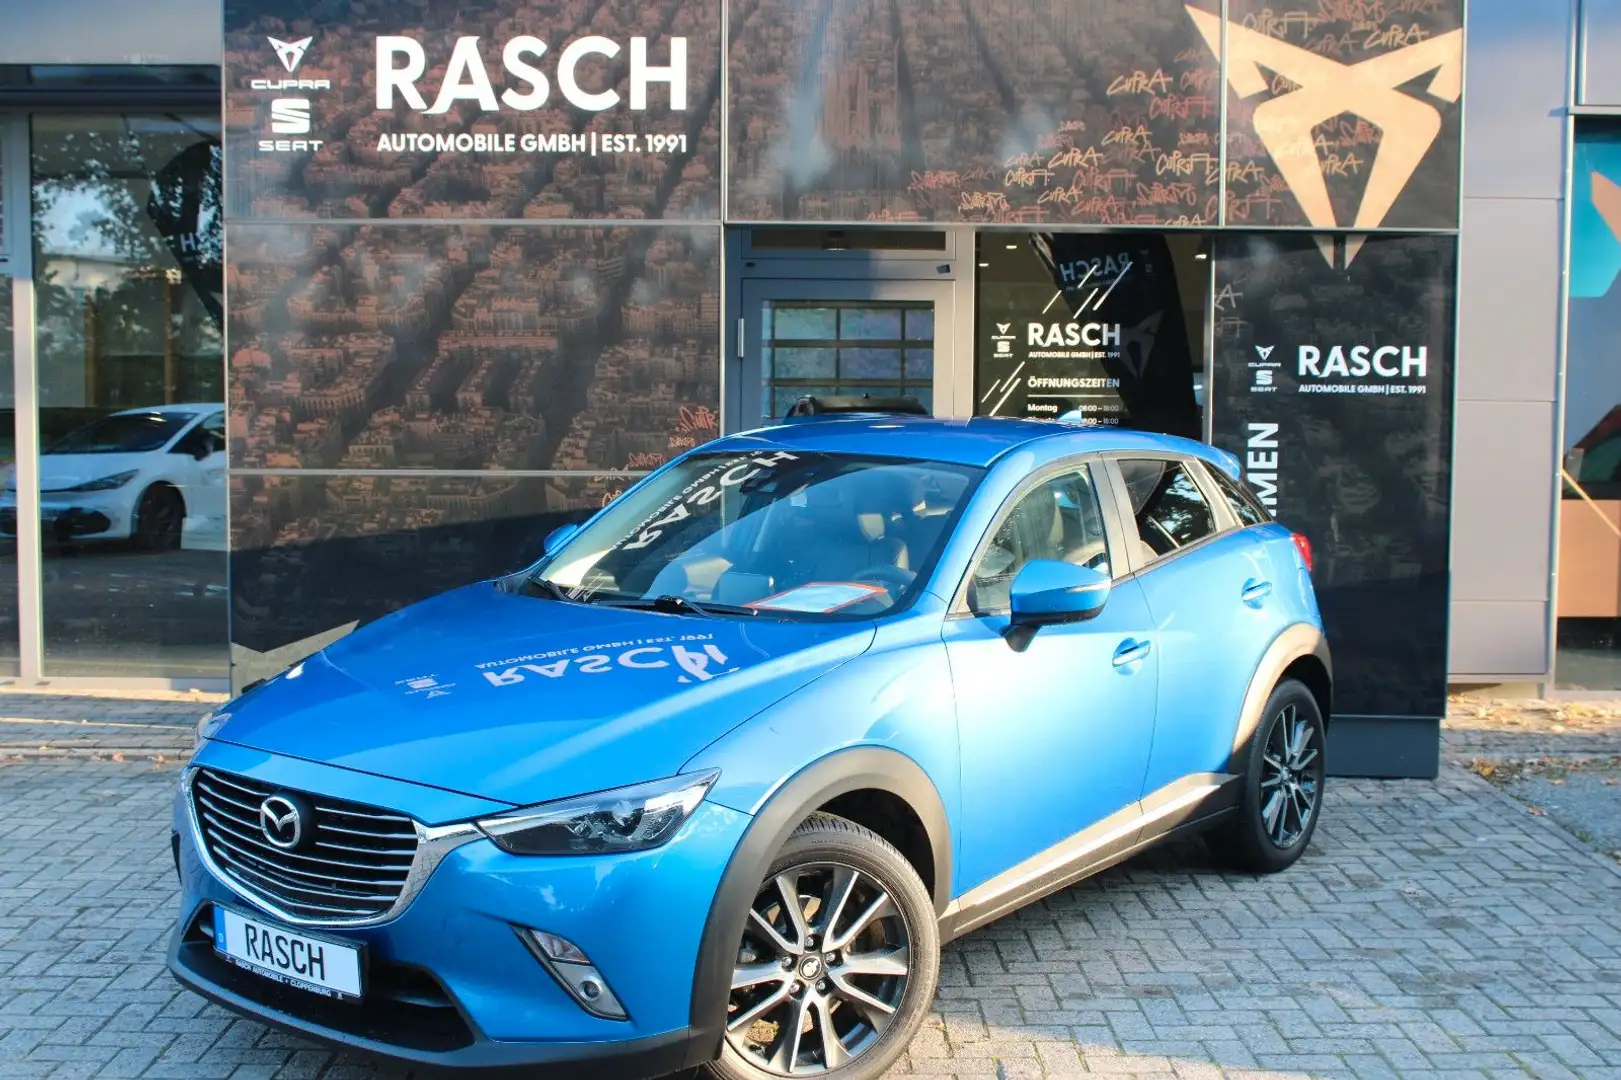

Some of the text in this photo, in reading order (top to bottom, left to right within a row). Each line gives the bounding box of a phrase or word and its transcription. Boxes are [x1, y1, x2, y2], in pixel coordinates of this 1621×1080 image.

[251, 79, 330, 90] CUPRA
[376, 35, 687, 114] RASCH
[1106, 68, 1173, 96] CUPRA
[258, 140, 323, 152] SEAT
[377, 133, 515, 153] AUTOMOBILE
[523, 133, 586, 153] GMBH
[601, 133, 641, 153] EST.
[646, 134, 688, 153] 1991
[1027, 322, 1120, 347] RASCH
[1028, 351, 1070, 359] AUTOMOBILE
[1298, 346, 1427, 378] RASCH
[1027, 375, 1120, 388] ÖFFNUNGSZEITEN
[1298, 384, 1356, 394] AUTOMOBILE
[1408, 385, 1426, 394] 1991
[1027, 403, 1058, 412] Montag
[1247, 423, 1279, 516] MEN
[244, 922, 326, 981] RASCH
